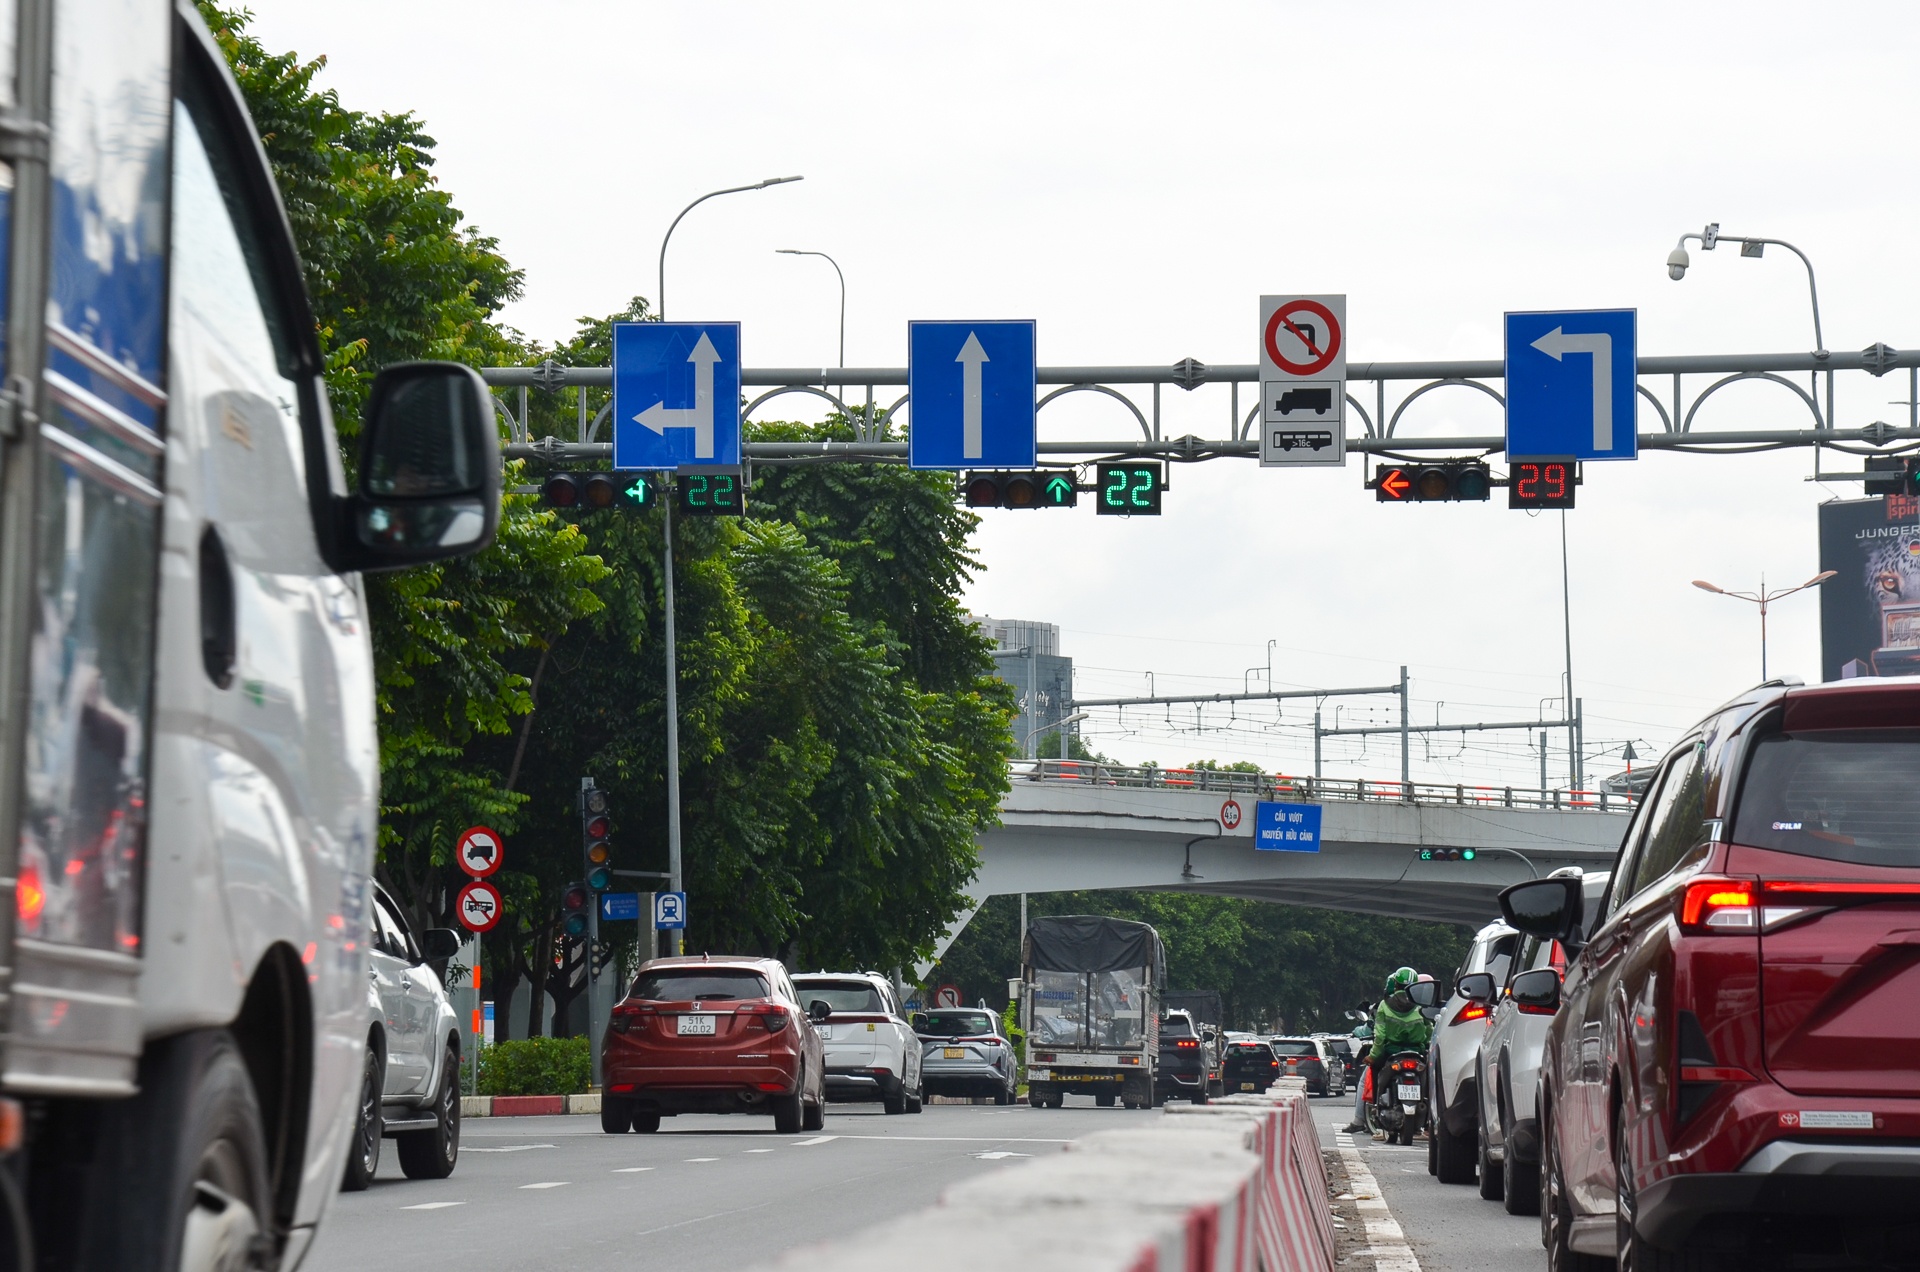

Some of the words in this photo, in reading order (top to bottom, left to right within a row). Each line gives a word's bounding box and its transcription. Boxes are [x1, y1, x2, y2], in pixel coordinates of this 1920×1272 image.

[688, 475, 733, 506] 22
[1106, 470, 1152, 506] 22
[1518, 464, 1565, 498] 29
[682, 1025, 712, 1033] 240.02
[688, 1016, 704, 1024] 51K
[1122, 1092, 1144, 1102] Stop
